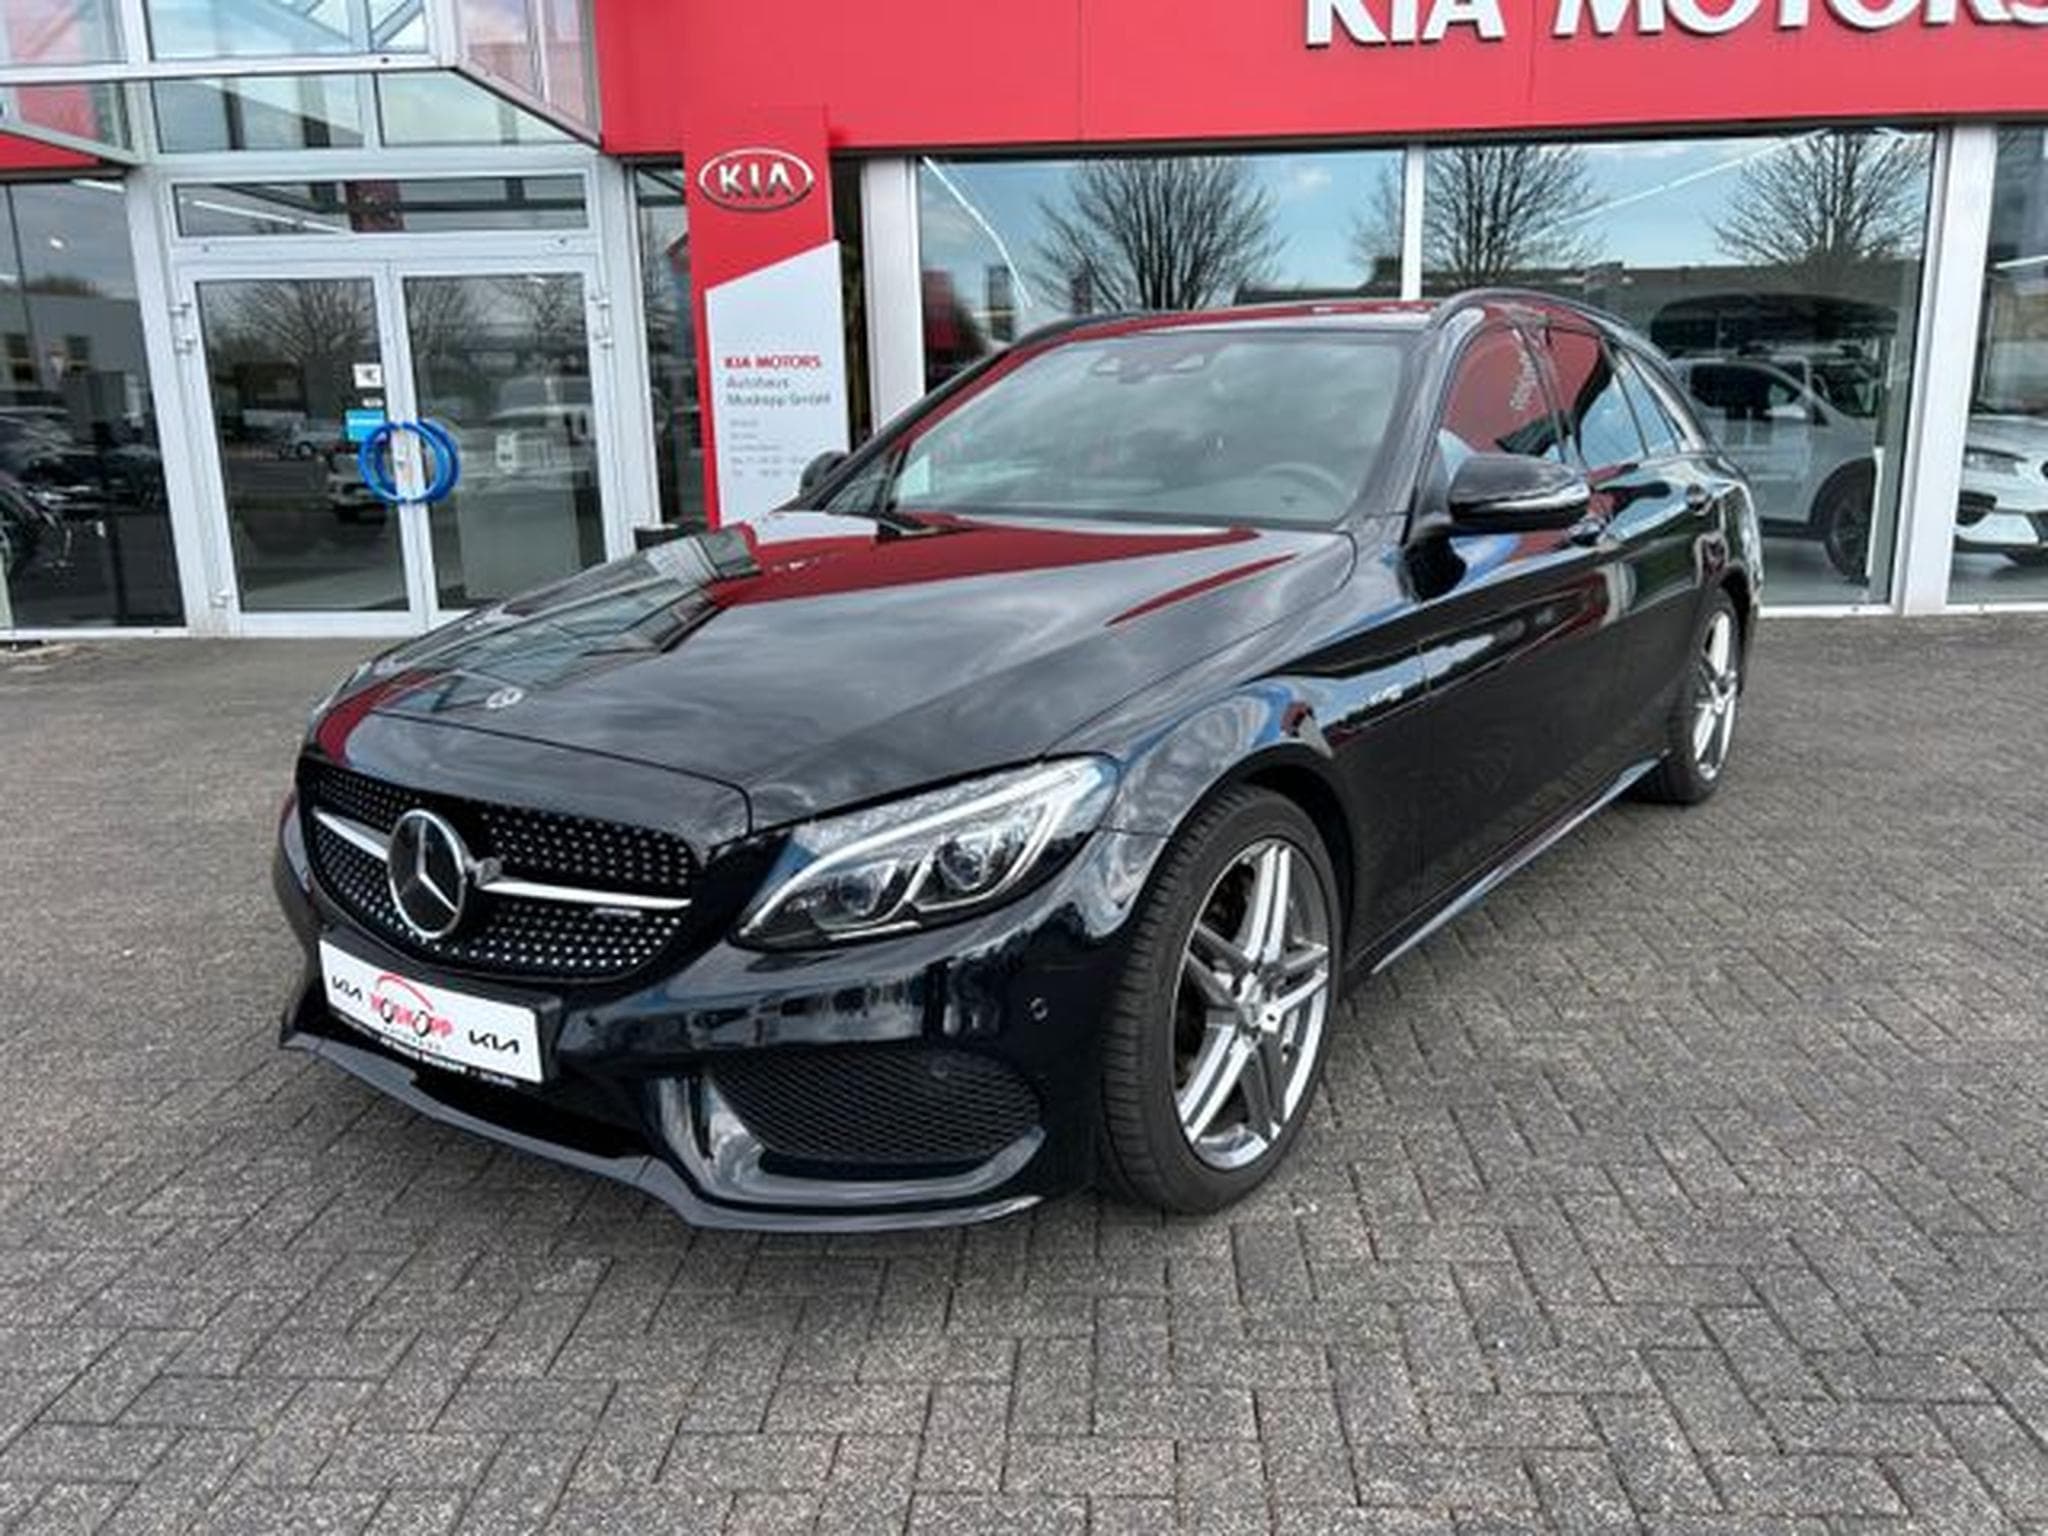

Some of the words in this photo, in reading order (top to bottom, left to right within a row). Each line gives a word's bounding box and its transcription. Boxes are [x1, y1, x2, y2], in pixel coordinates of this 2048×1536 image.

[719, 162, 795, 197] KIA
[725, 356, 751, 369] KIA
[755, 354, 820, 369] MOTORS
[468, 1029, 520, 1055] KIA
